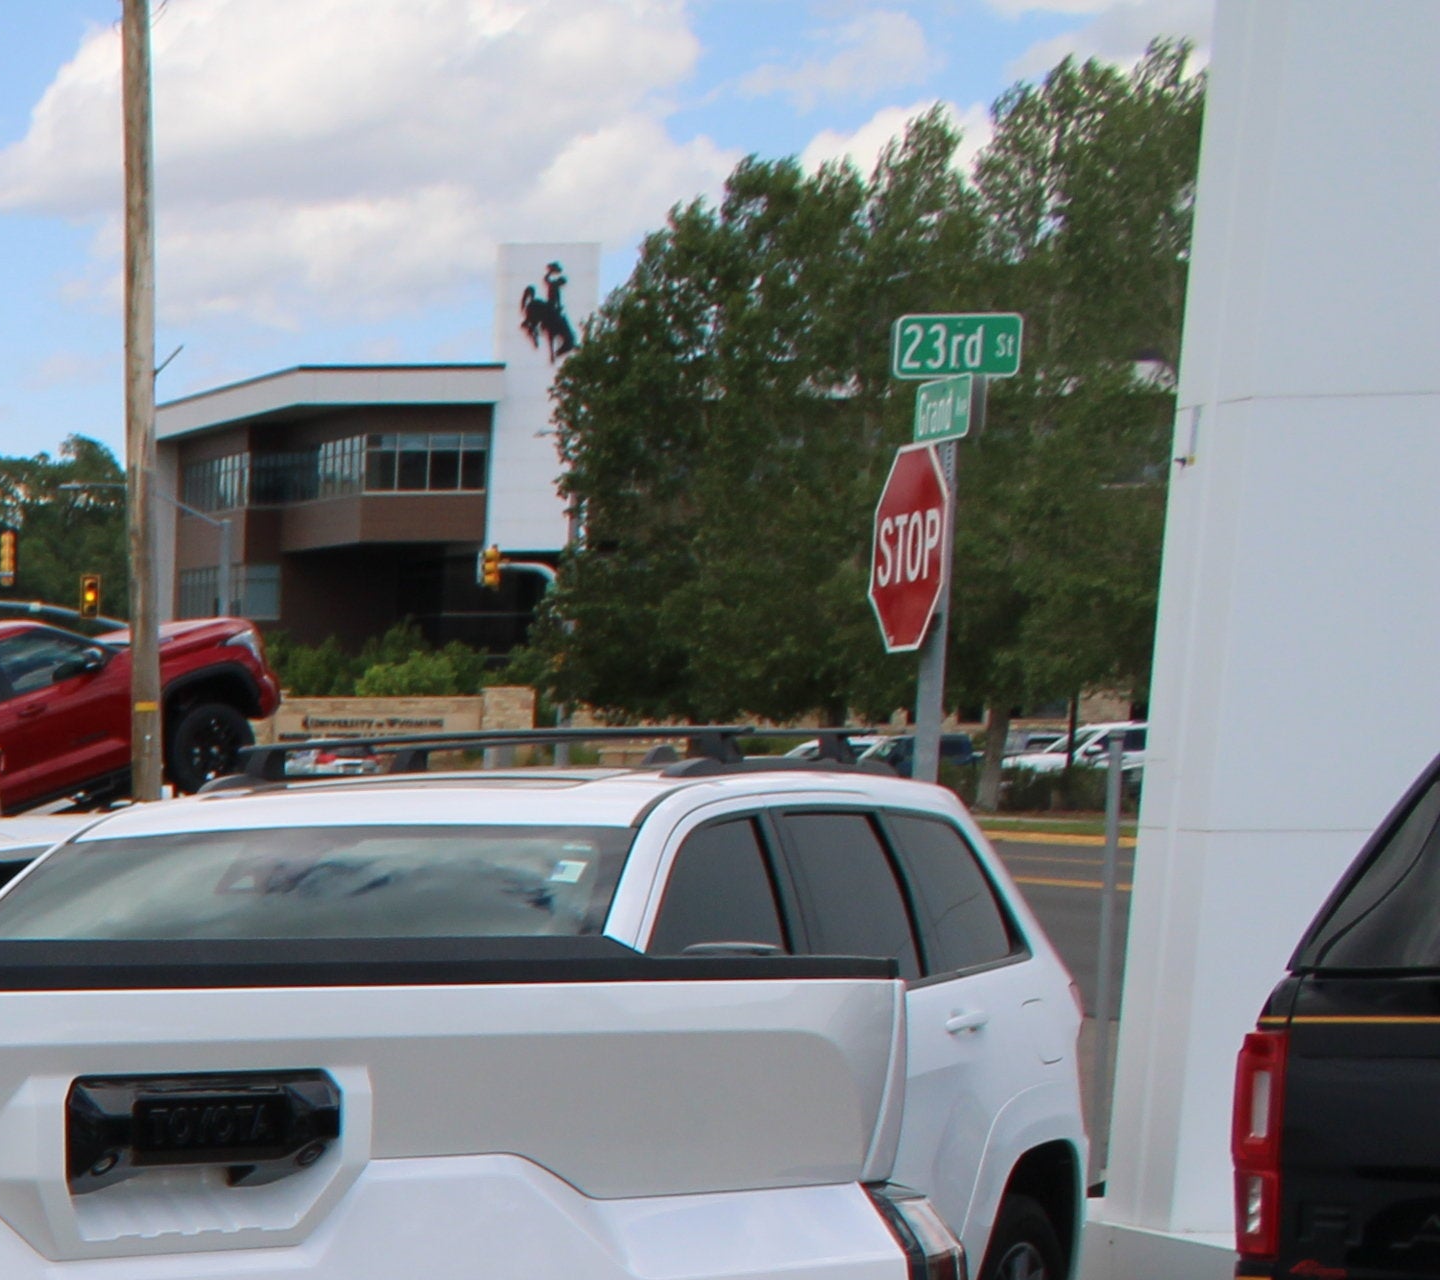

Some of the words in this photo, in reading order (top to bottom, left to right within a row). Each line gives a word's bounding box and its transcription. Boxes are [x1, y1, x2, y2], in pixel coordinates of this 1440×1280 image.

[901, 323, 984, 369] 23rd
[995, 332, 1015, 358] St
[917, 388, 954, 437] Grand
[877, 508, 941, 588] STOP
[149, 1103, 275, 1145] TOYOTA
